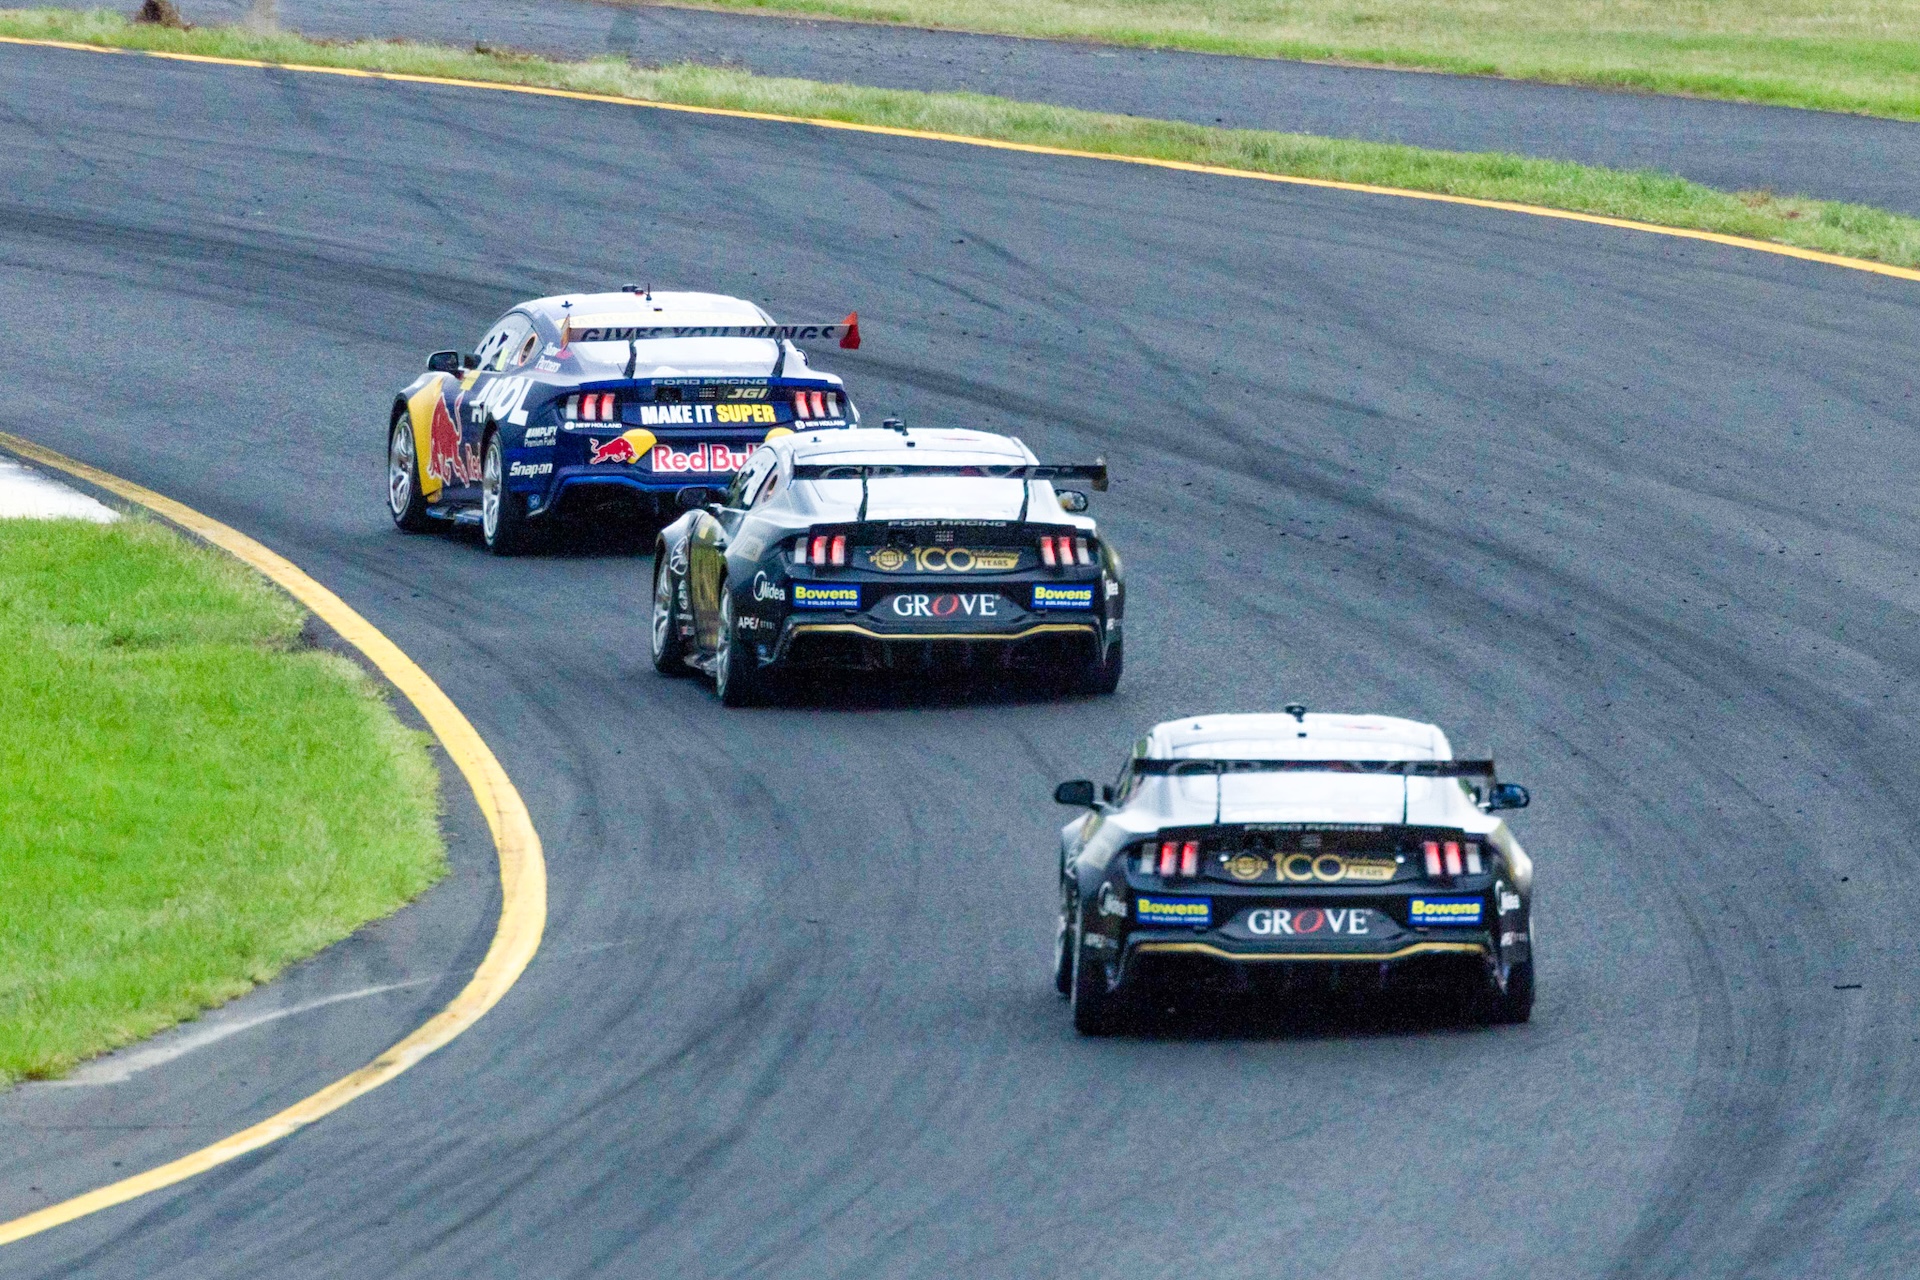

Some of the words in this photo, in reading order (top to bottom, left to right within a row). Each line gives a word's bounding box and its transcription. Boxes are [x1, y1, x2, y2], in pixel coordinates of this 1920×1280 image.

[651, 378, 700, 386] FORD
[704, 378, 768, 386] RACING
[727, 388, 768, 399] JGI
[640, 404, 693, 425] MAKE
[695, 404, 713, 423] IT
[716, 404, 777, 423] SUPER
[653, 443, 709, 472] Red
[710, 443, 762, 472] Bu
[509, 461, 553, 478] Snap-on
[753, 570, 786, 601] Midea
[795, 586, 858, 600] Bowens
[1035, 586, 1092, 600] Bowens
[892, 593, 998, 617] GROVE
[1138, 899, 1209, 916] Bowens
[1411, 899, 1480, 915] Bowens
[1247, 908, 1369, 935] GROVE
